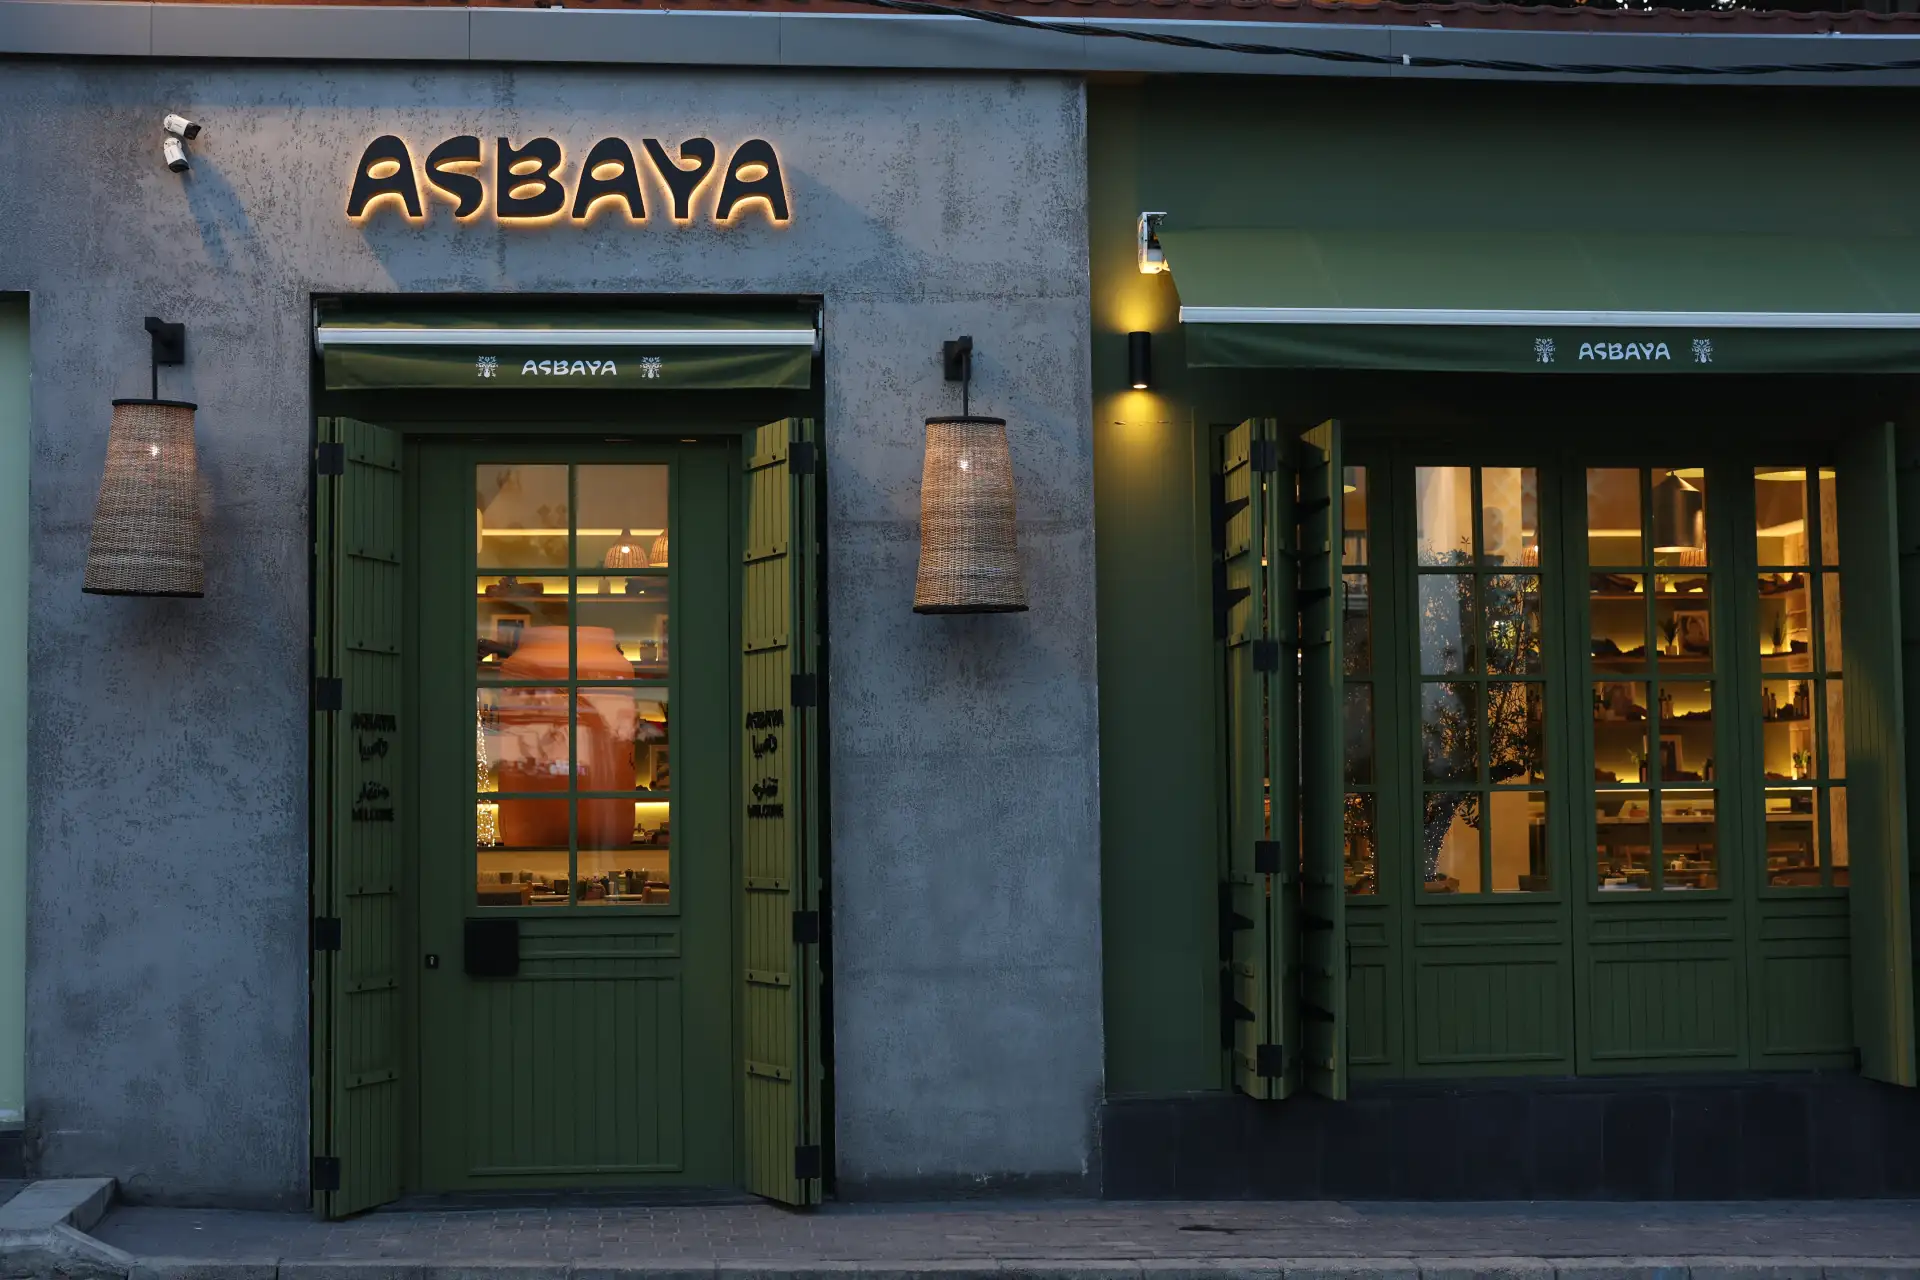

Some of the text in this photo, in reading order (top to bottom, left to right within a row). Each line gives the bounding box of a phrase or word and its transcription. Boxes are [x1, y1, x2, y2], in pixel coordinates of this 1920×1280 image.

[346, 135, 789, 220] ASBAYA
[1578, 342, 1671, 360] ASBAYA
[521, 359, 617, 376] ASBAYA
